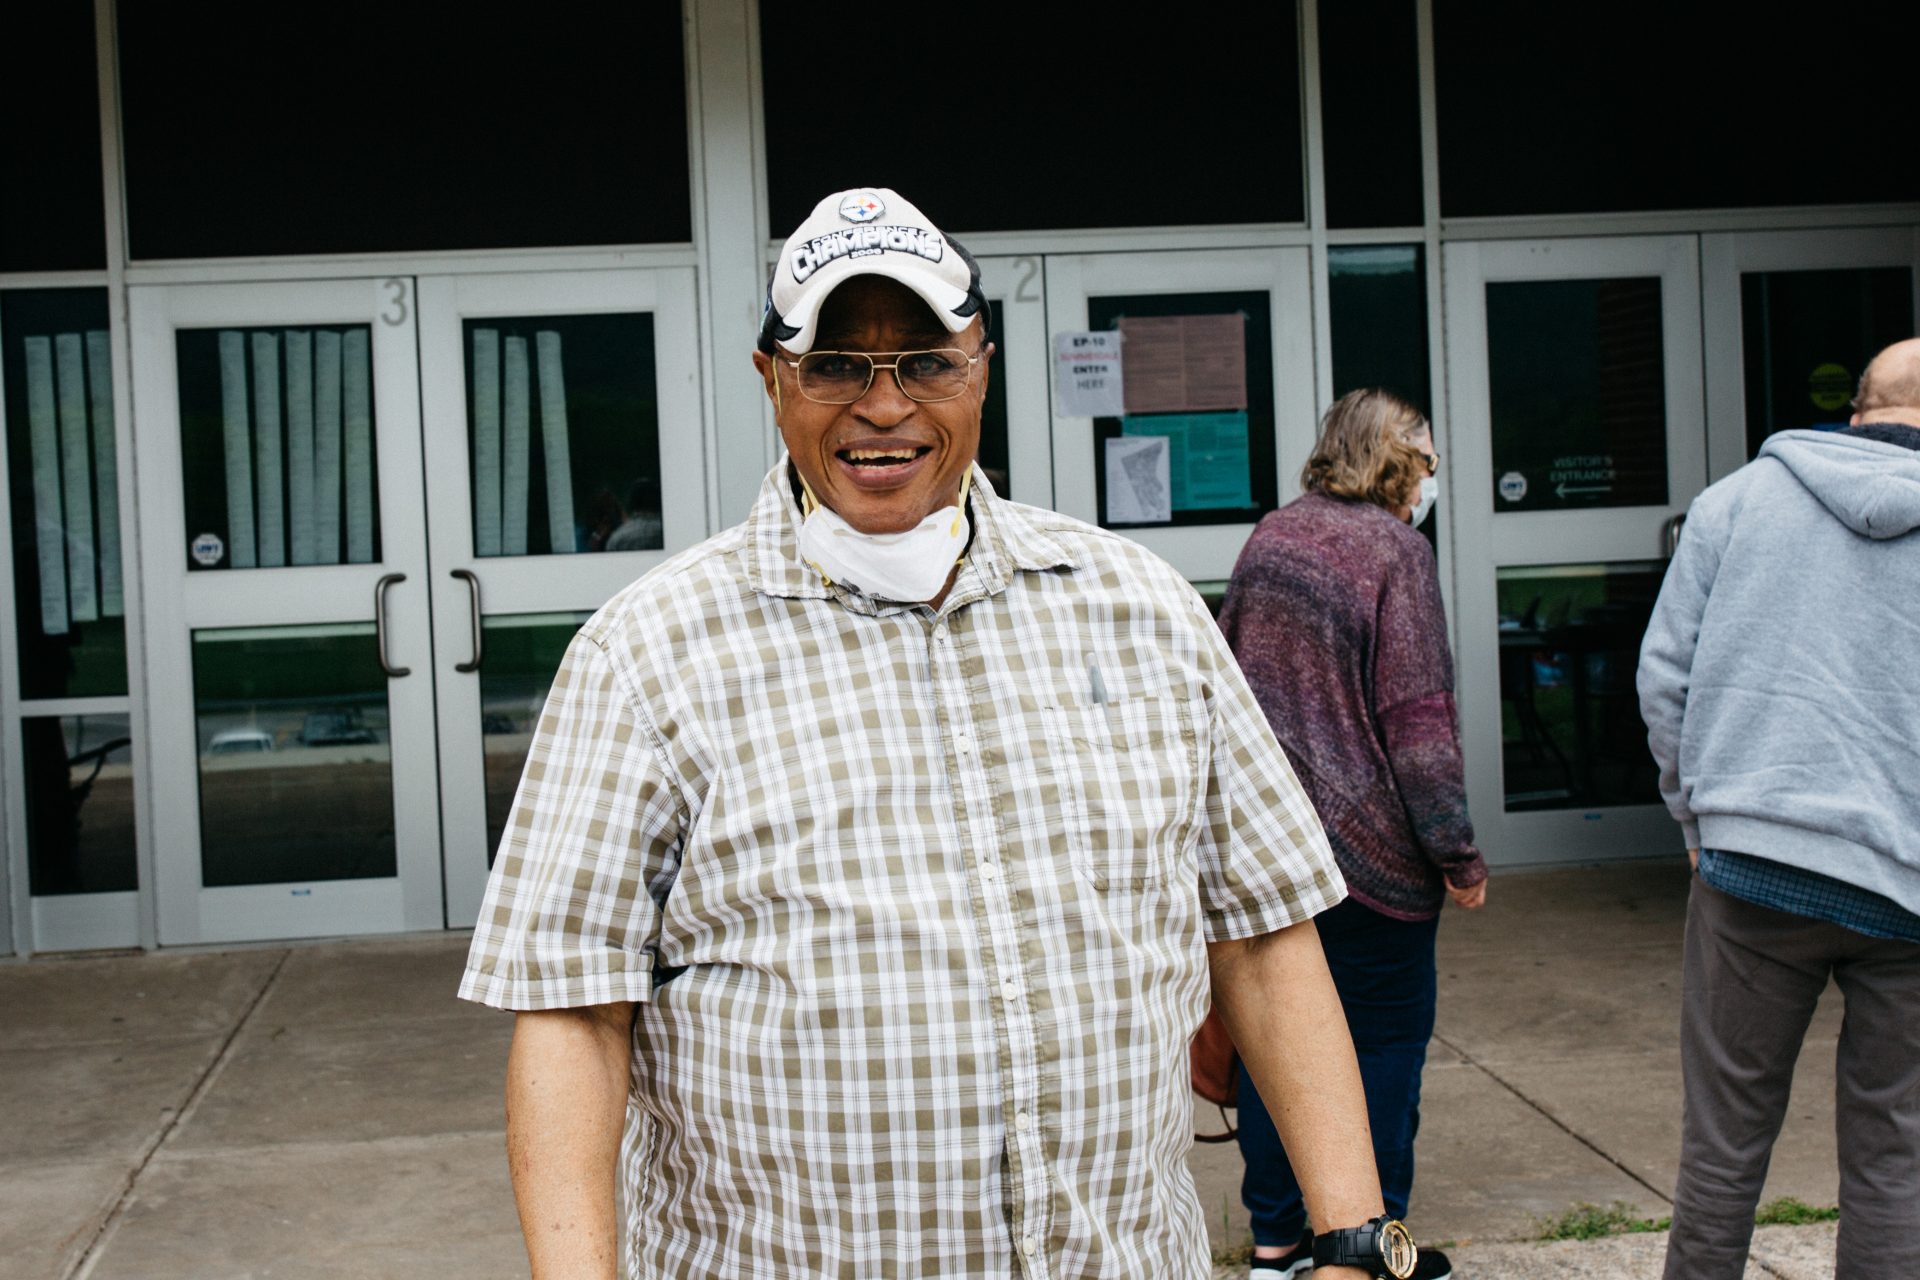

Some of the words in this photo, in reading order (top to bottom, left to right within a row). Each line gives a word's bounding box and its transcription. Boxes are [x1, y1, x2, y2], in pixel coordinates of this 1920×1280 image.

[790, 230, 943, 283] CHAMPIONS
[1012, 256, 1040, 303] 2
[382, 279, 408, 327] 3
[1073, 365, 1108, 374] ENTER
[1077, 379, 1104, 389] HERE
[1550, 470, 1616, 482] ENTRANCE
